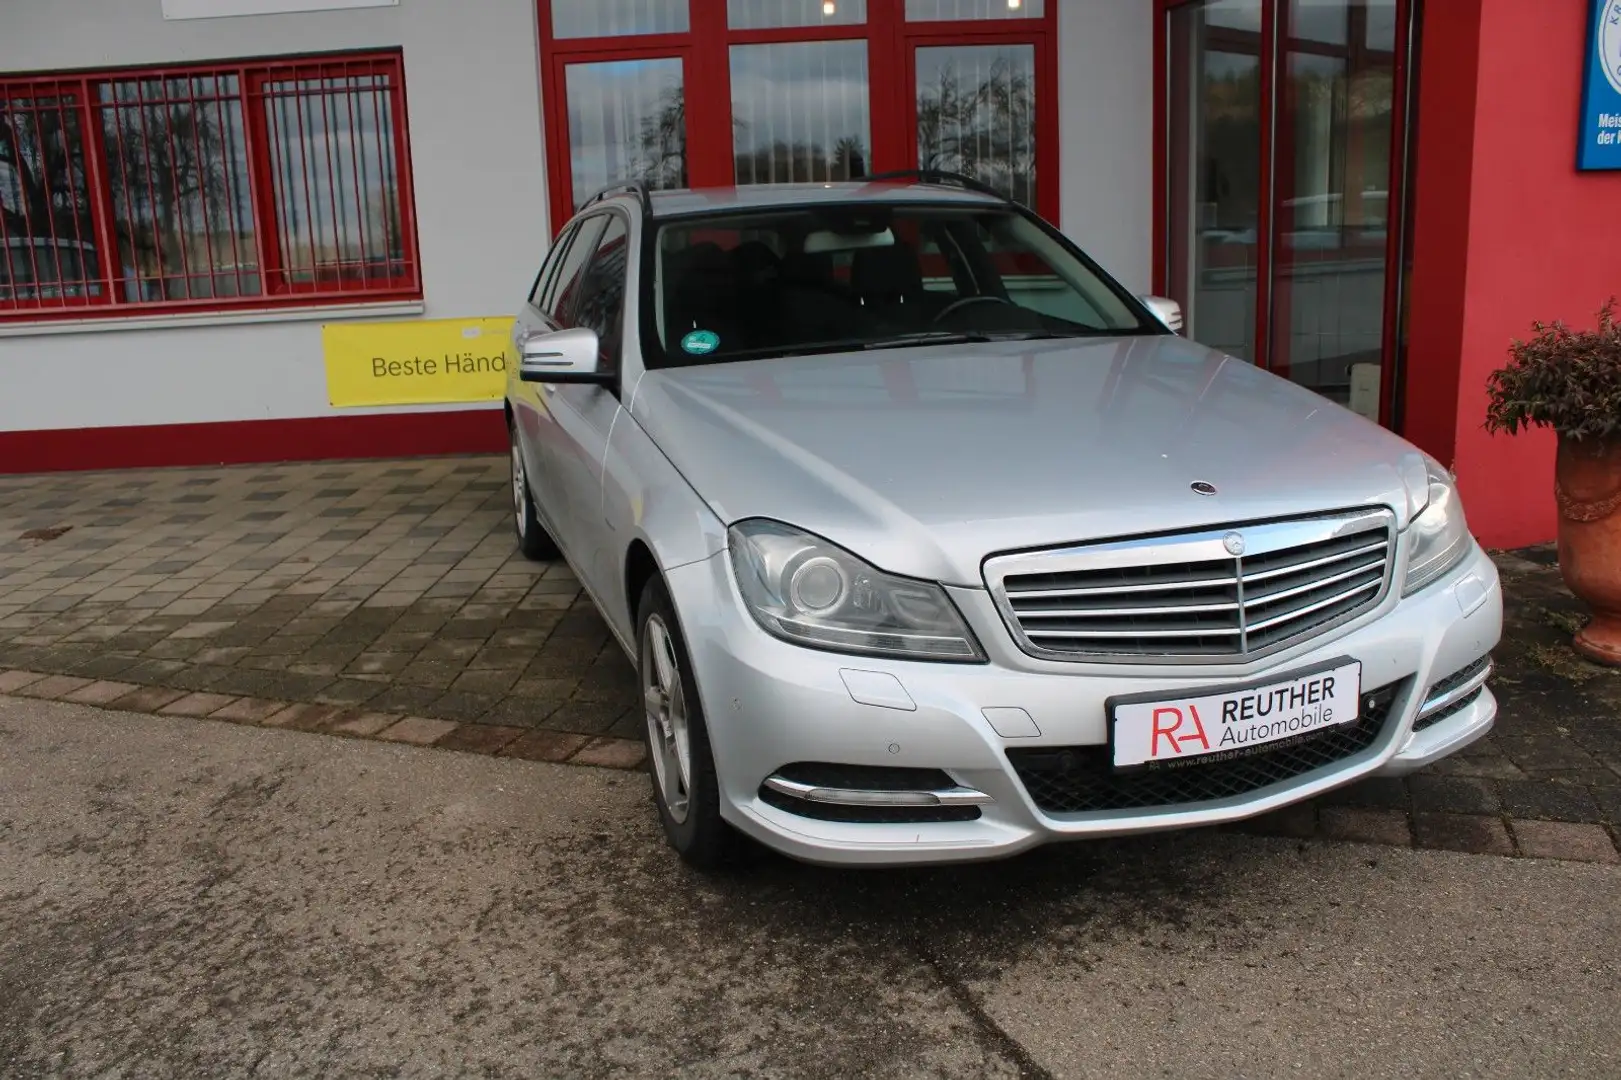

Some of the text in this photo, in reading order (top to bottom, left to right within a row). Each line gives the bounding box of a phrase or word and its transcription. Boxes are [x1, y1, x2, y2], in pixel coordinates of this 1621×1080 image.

[1597, 130, 1617, 145] der
[372, 351, 507, 378] Beste Händ
[1221, 676, 1335, 724] REUTHER
[1151, 705, 1210, 757] RA
[1219, 704, 1333, 747] Automobile
